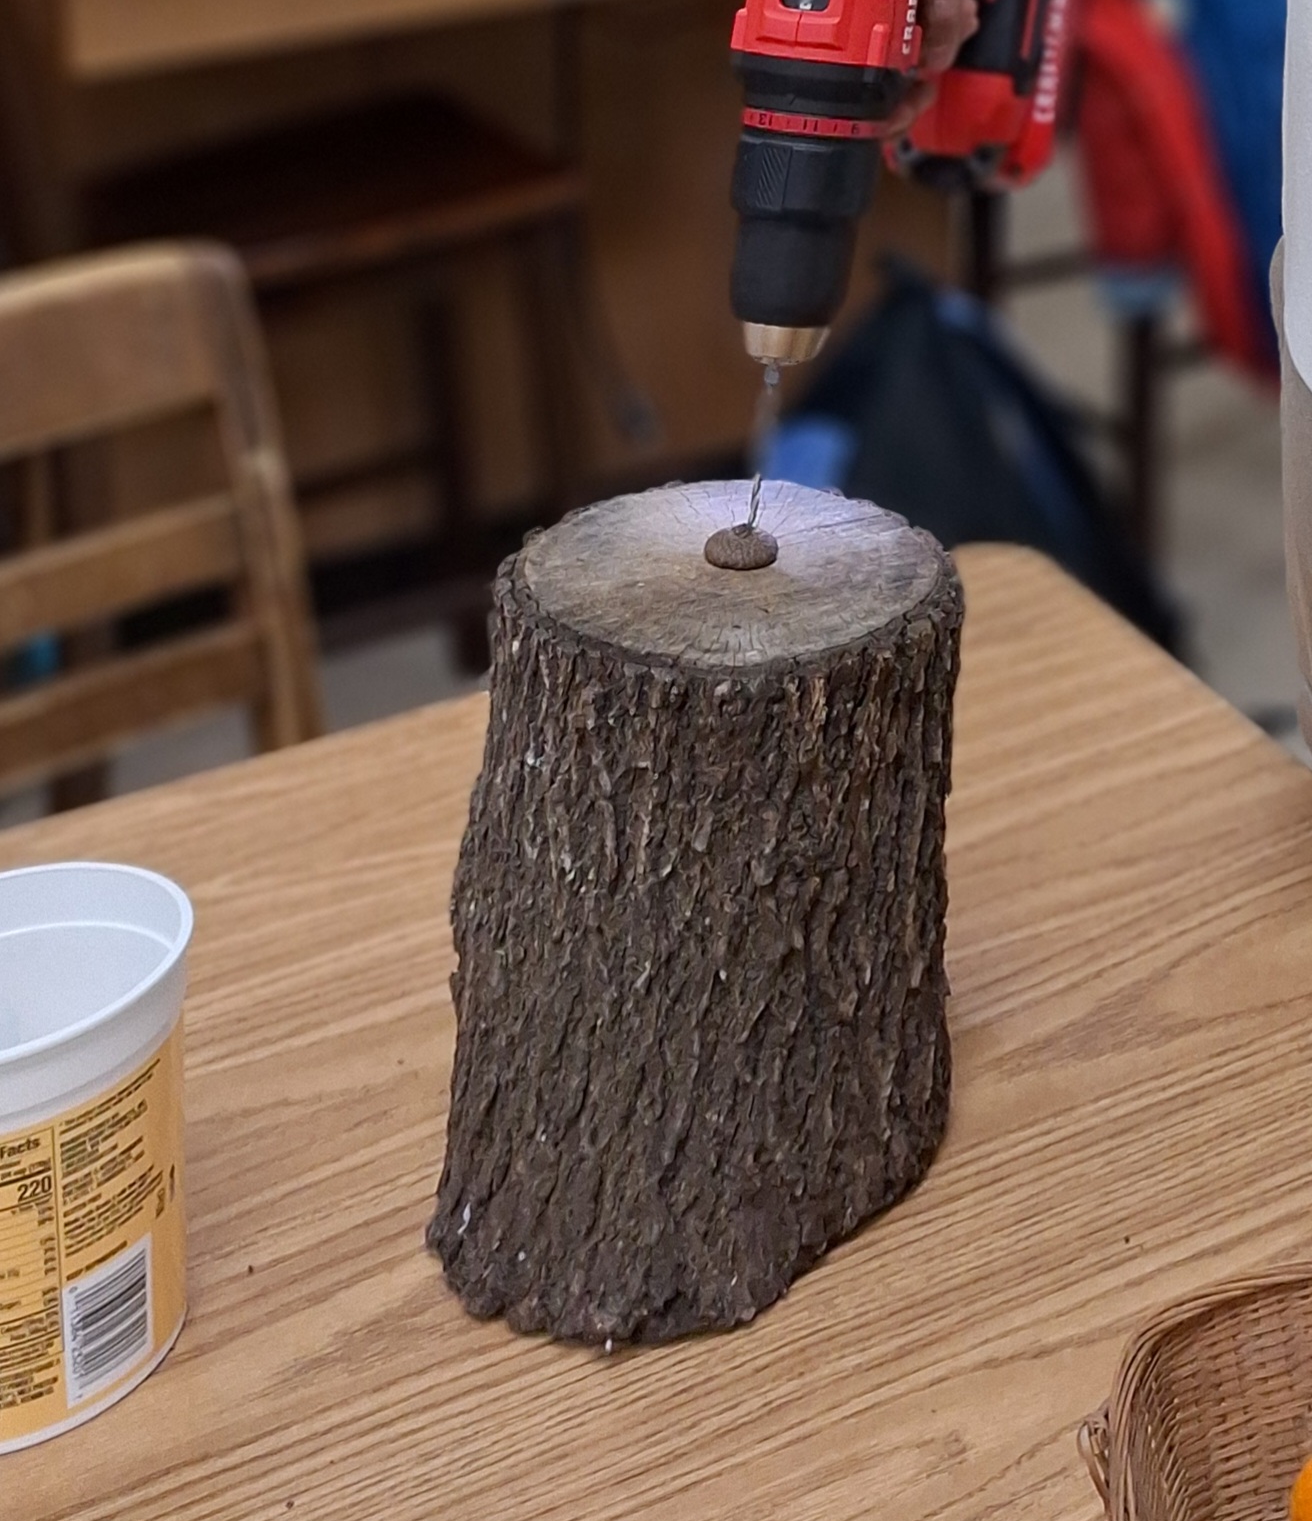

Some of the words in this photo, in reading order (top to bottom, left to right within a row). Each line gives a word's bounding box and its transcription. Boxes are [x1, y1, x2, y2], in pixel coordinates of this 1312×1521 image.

[757, 113, 773, 126] 13
[802, 119, 819, 132] 11
[0, 1138, 41, 1159] Facts
[16, 1174, 52, 1202] 220
